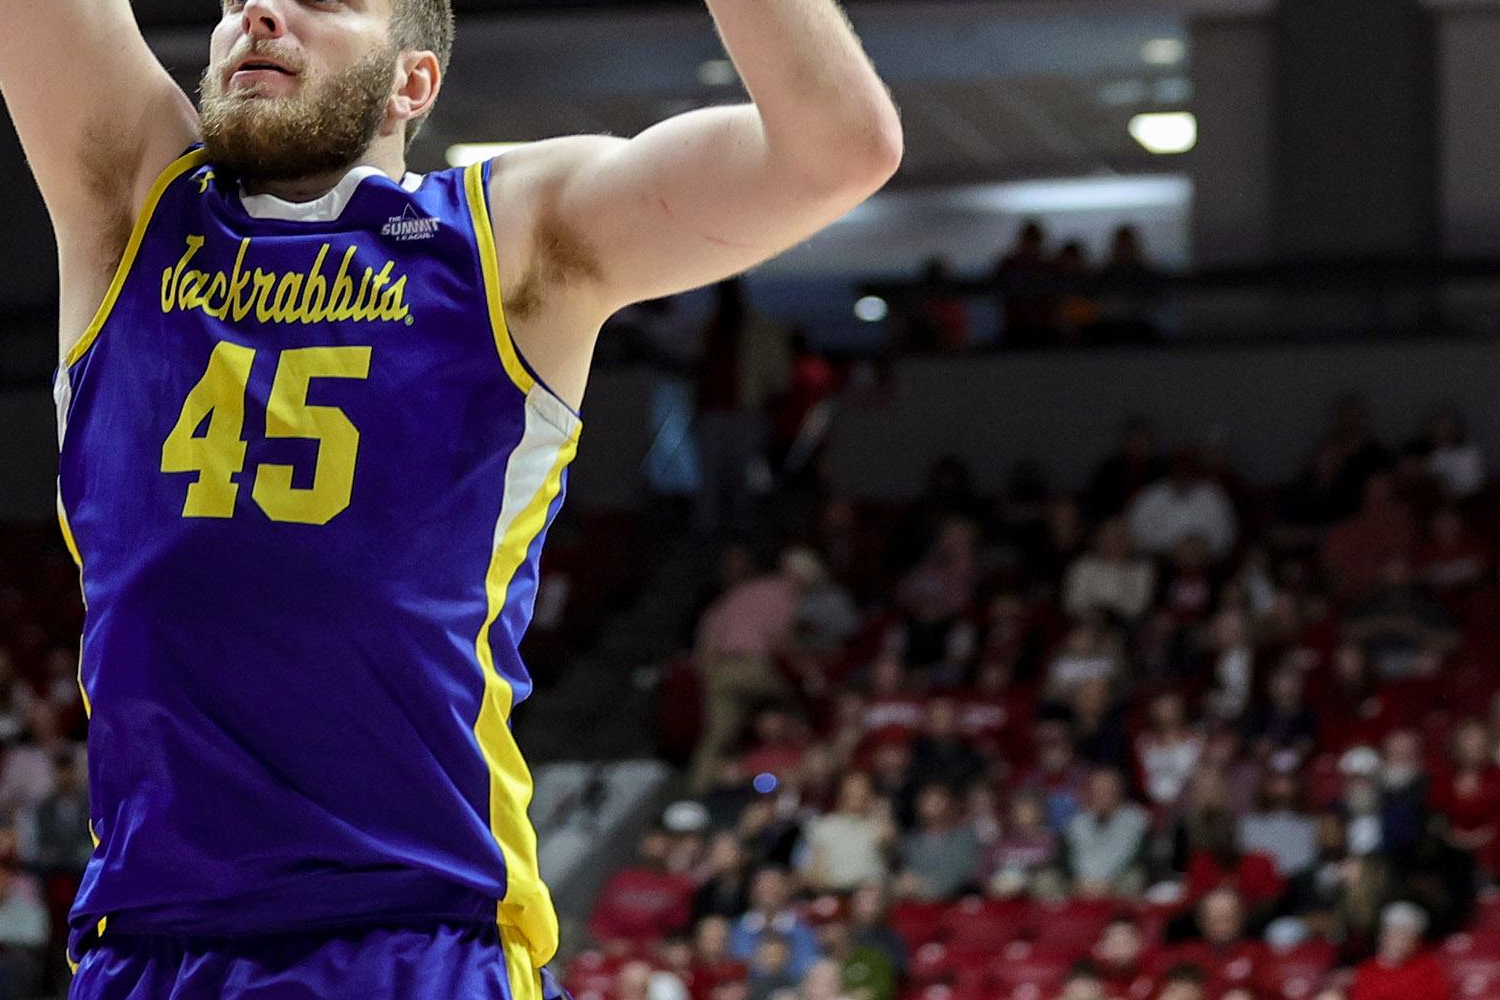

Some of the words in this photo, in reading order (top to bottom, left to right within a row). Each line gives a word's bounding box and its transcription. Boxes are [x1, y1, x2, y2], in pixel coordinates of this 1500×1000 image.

[381, 216, 441, 236] SUMMIT
[388, 215, 401, 223] THE
[161, 235, 408, 325] Jackrabbits
[160, 341, 372, 525] 45
